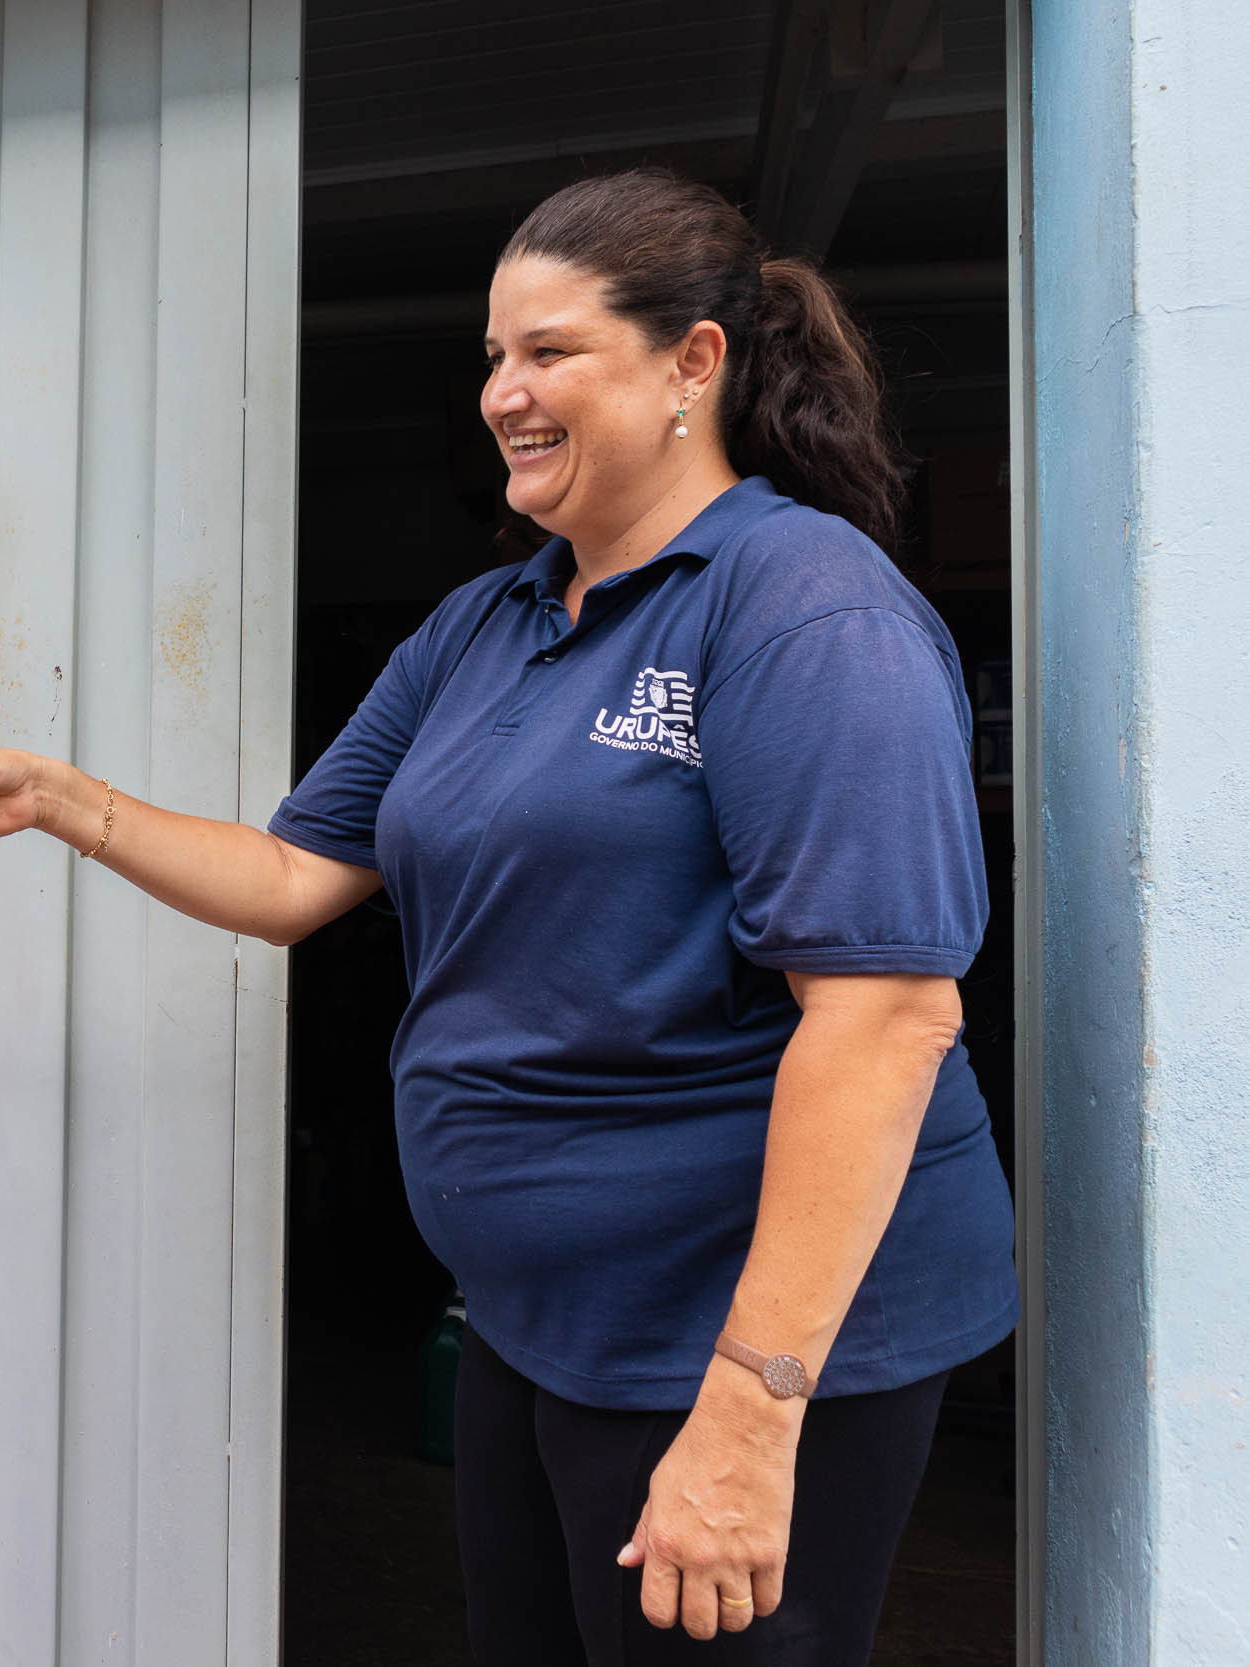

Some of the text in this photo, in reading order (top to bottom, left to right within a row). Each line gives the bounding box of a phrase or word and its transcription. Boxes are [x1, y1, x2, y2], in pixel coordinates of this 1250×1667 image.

[589, 732, 639, 751] GOVERNO
[641, 741, 658, 752] DO
[595, 708, 702, 758] URUPÊS
